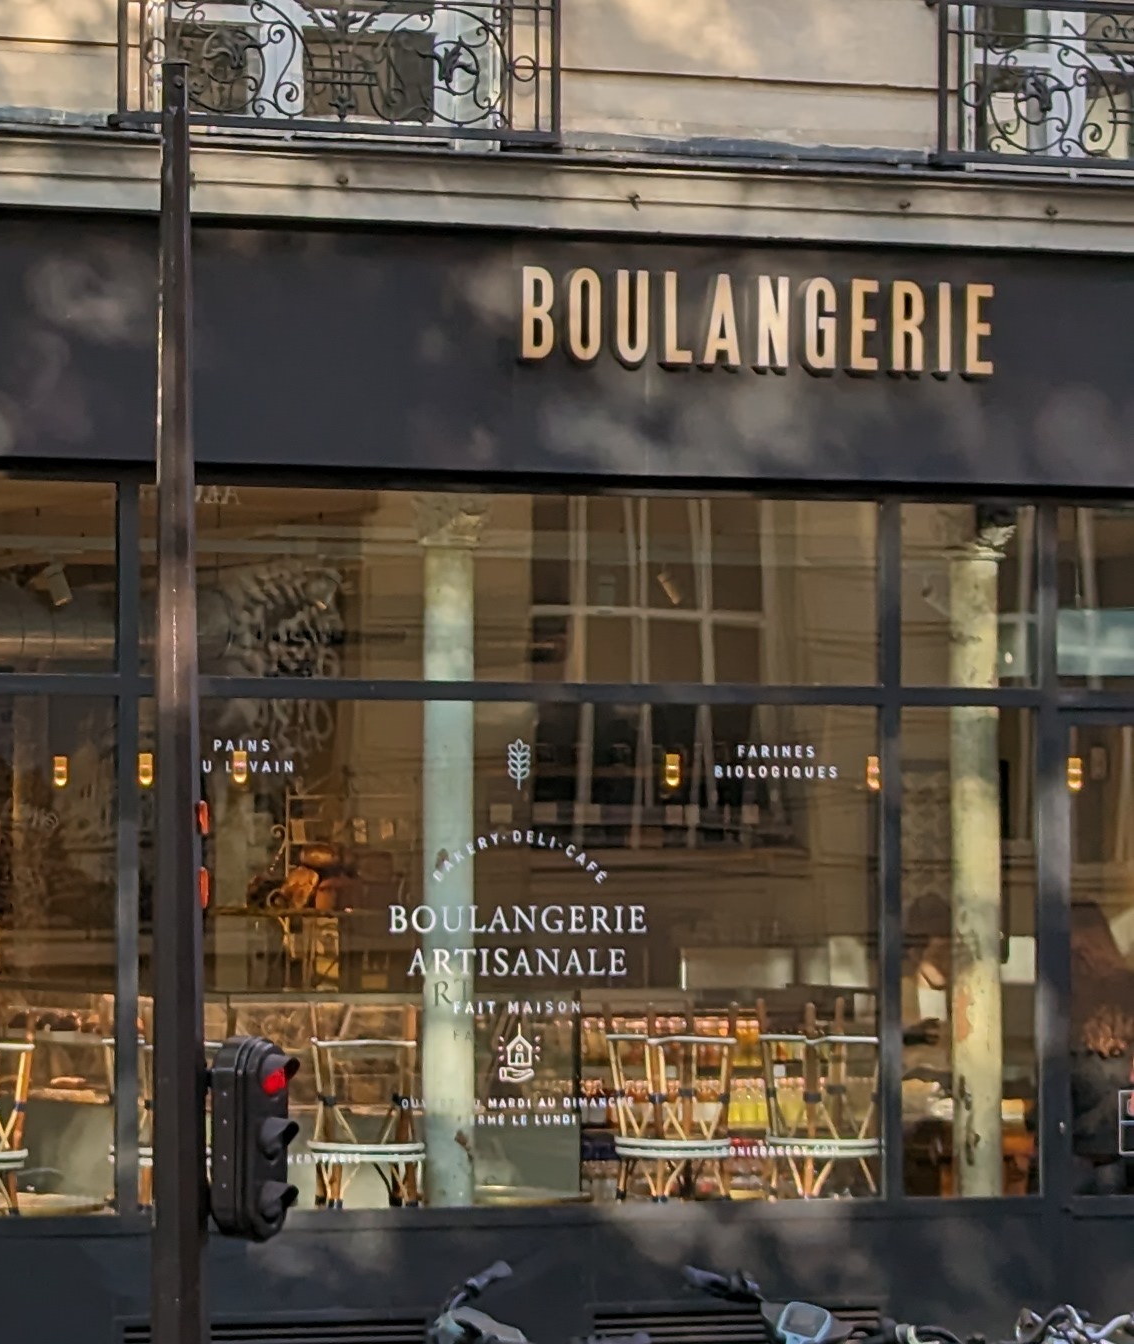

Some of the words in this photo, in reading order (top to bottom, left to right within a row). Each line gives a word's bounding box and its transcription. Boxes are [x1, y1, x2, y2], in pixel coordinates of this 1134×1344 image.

[521, 265, 995, 375] BOULANGERIE
[213, 739, 270, 752] PAINS
[737, 744, 815, 758] FARINES
[202, 760, 212, 773] U
[225, 760, 294, 773] LVAIN
[714, 764, 838, 779] BIOLOGIQUES
[388, 905, 647, 934] BOULANGERIE
[407, 948, 628, 976] ARTISANALE
[453, 1001, 496, 1014] FAIT
[508, 1001, 581, 1014] MAISON
[488, 1097, 531, 1109] MARDI
[538, 1097, 556, 1109] AU
[469, 1112, 505, 1126] ERMÉ
[512, 1114, 527, 1126] LE
[535, 1114, 576, 1126] LUNDI
